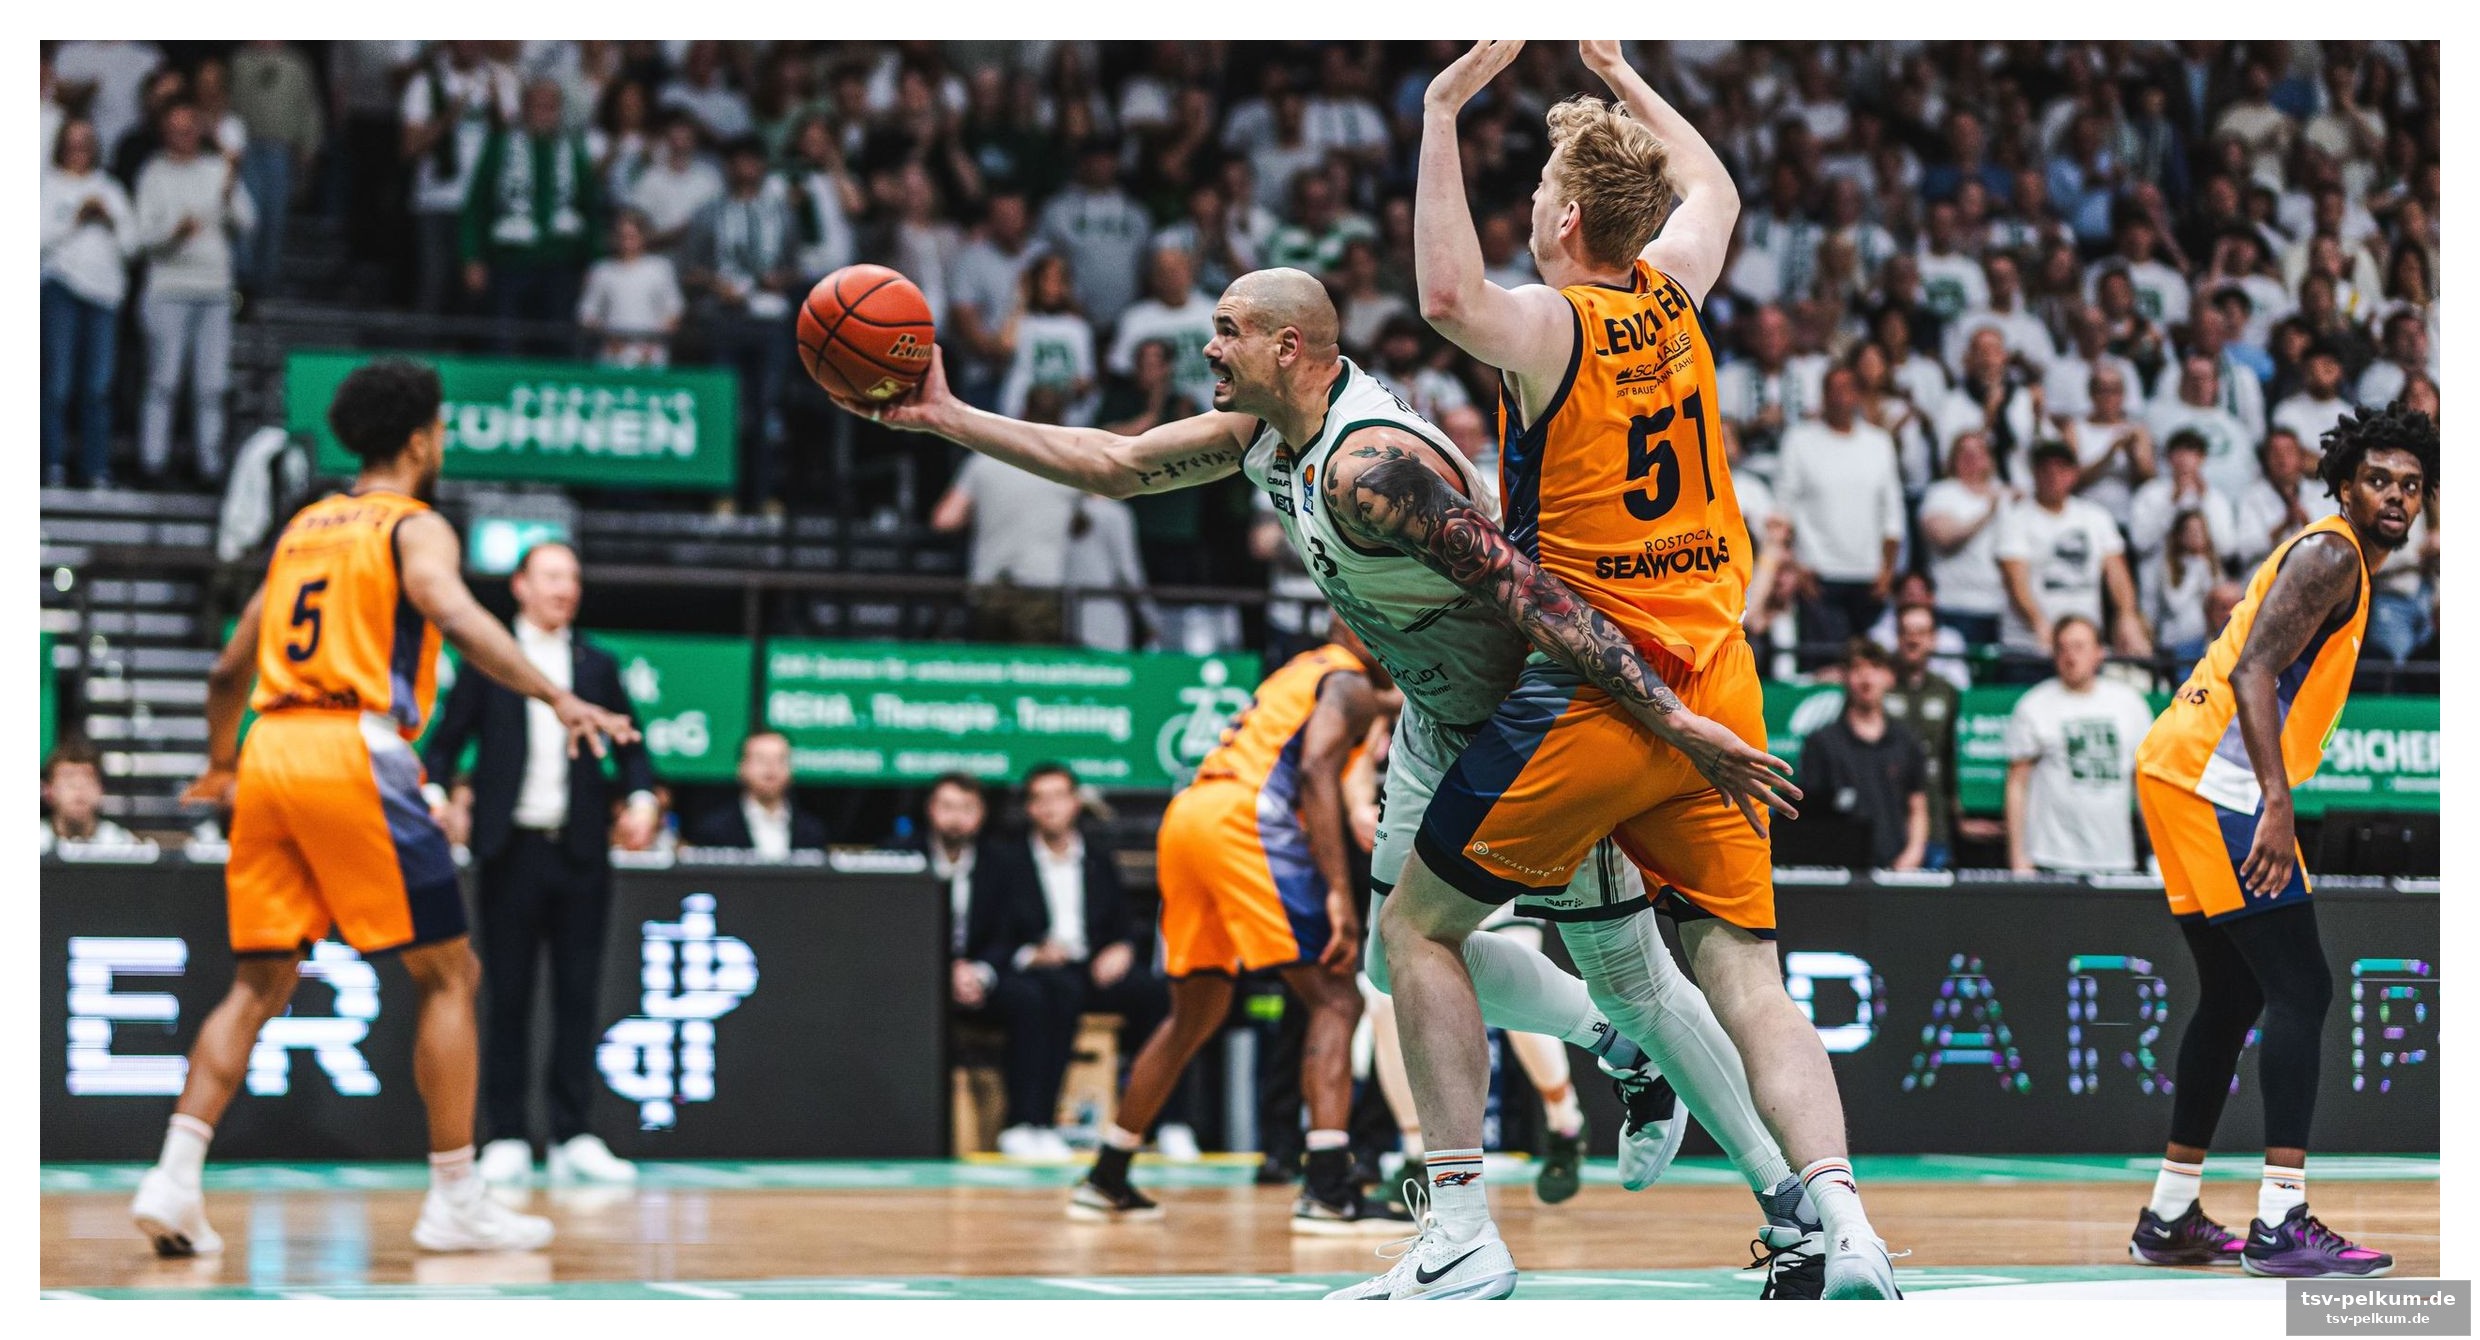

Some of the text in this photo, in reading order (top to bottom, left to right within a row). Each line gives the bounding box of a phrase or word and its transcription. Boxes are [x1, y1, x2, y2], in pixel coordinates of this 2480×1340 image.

[1623, 384, 1715, 521] 51
[1644, 527, 1714, 554] ROSTOCK
[286, 576, 328, 662] 5
